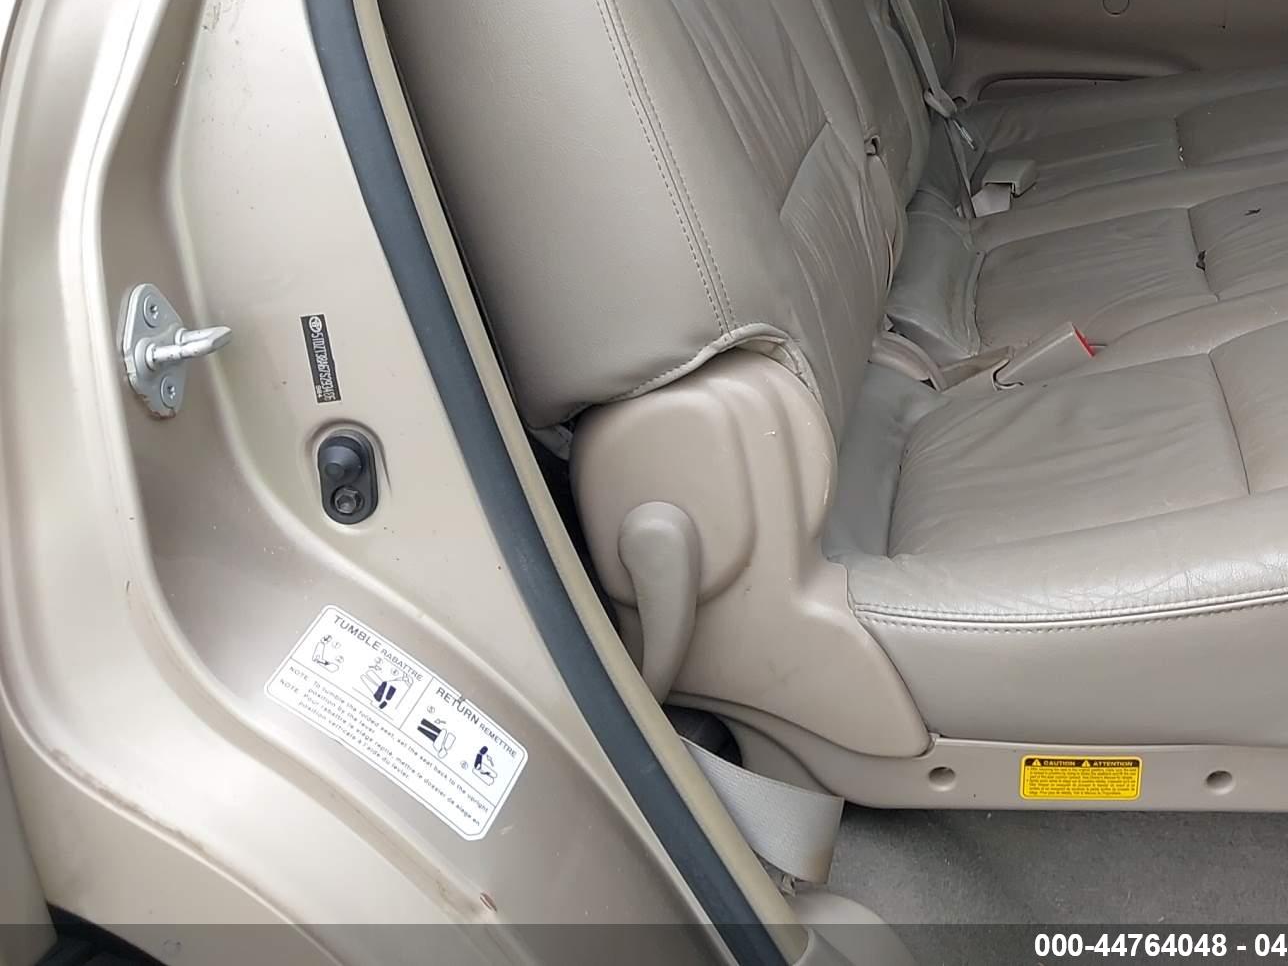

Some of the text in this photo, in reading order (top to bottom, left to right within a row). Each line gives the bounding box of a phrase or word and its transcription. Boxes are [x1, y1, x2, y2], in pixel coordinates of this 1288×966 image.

[334, 615, 423, 681] TUMBLE RABATTRE
[436, 687, 517, 759] RETURN REMETTRE
